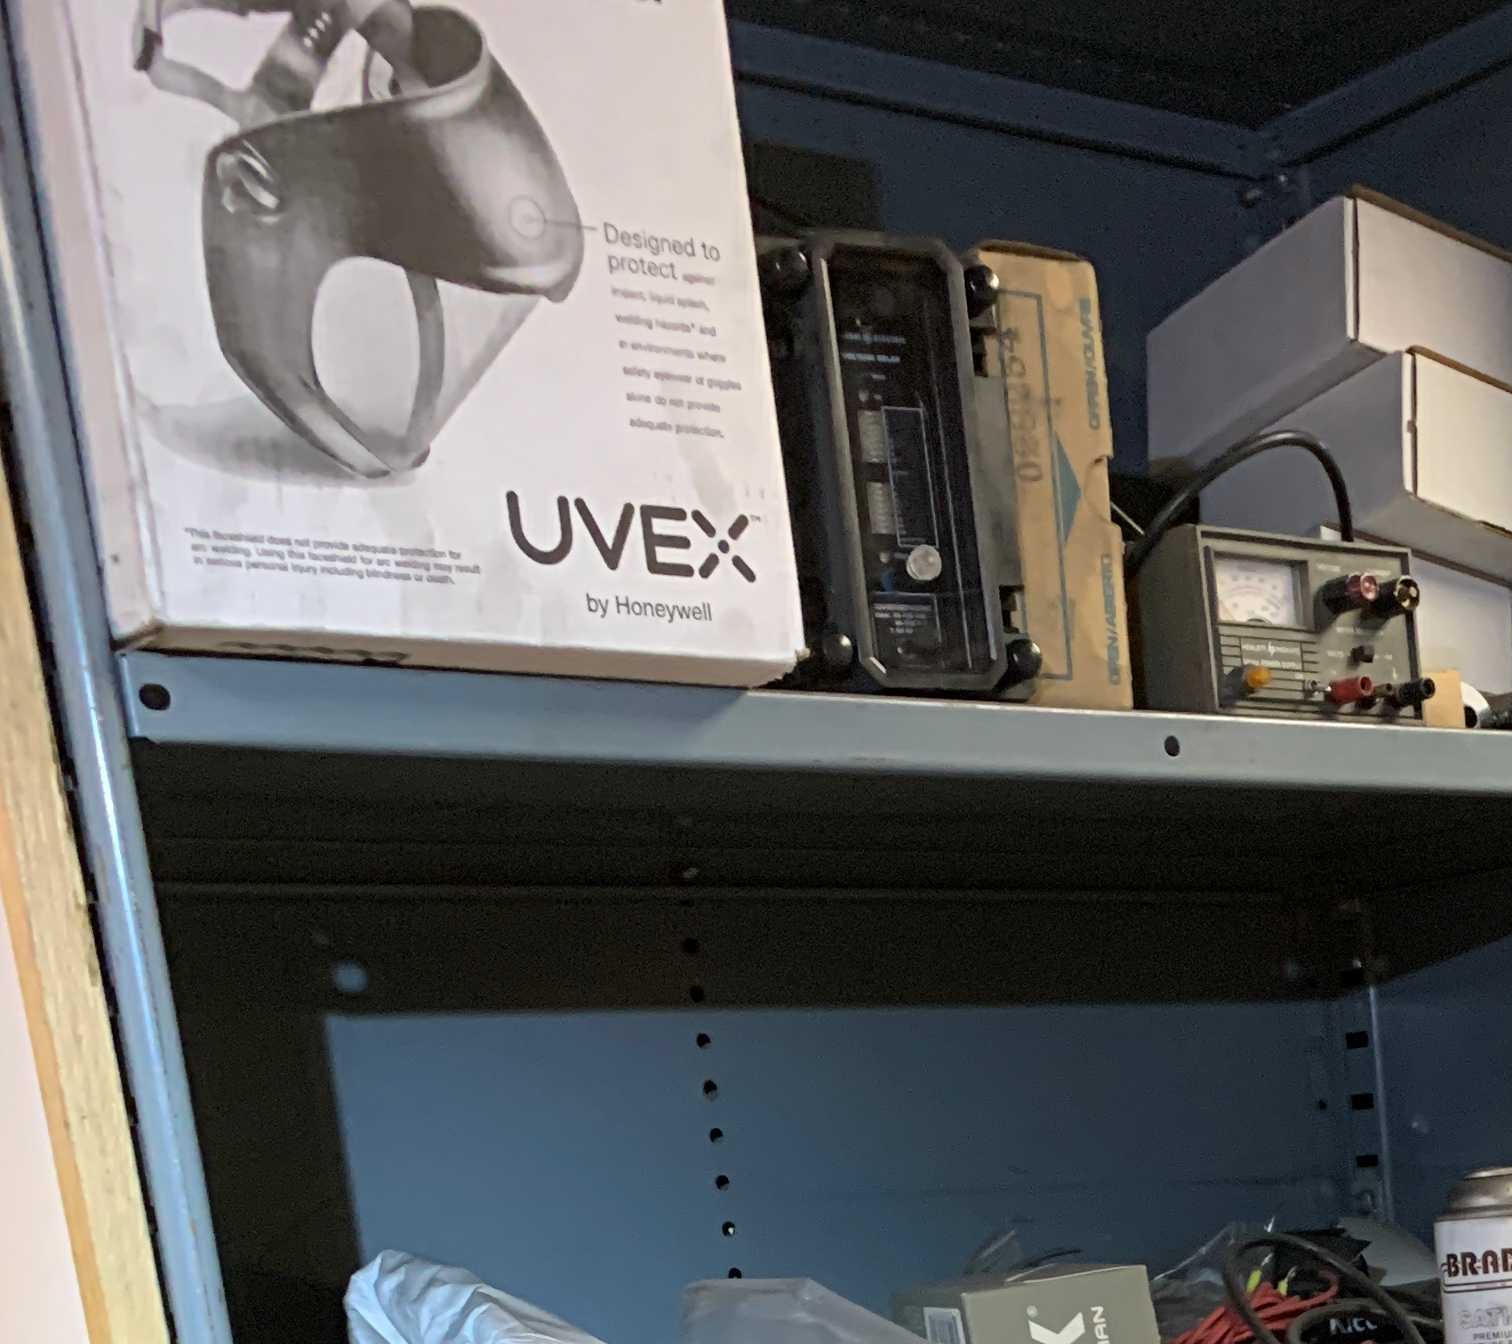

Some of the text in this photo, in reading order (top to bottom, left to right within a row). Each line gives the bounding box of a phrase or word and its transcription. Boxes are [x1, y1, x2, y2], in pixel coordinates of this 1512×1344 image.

[603, 222, 721, 262] Designed to
[608, 255, 678, 280] protect
[506, 490, 756, 583] UVEX
[586, 593, 712, 623] by Honeywell
